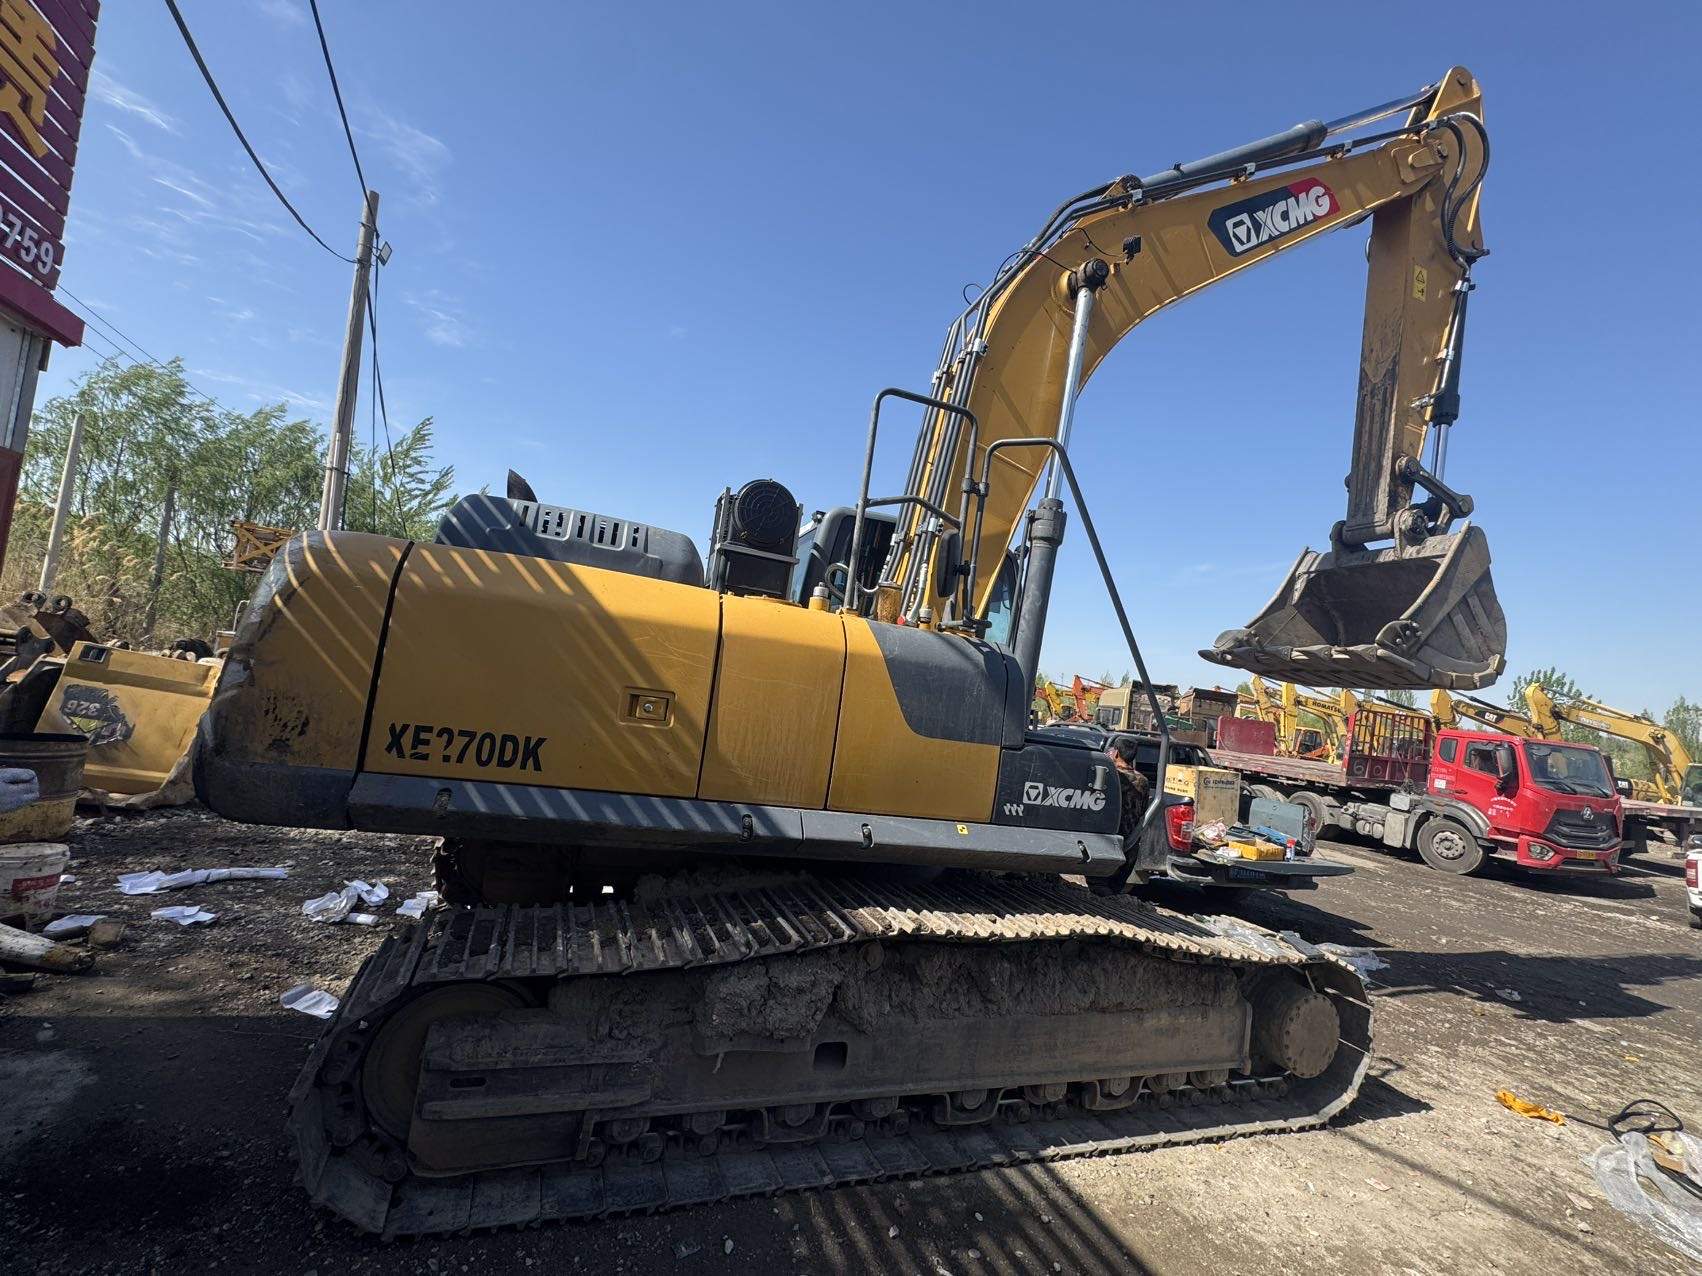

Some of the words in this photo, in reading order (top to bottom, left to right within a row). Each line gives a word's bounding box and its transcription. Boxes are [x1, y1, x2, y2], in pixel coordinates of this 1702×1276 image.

[1253, 185, 1330, 243] XCMG
[0, 205, 54, 275] 759
[1484, 712, 1497, 722] CAT
[1617, 780, 1629, 789] CAT
[1041, 786, 1106, 811] XCMG
